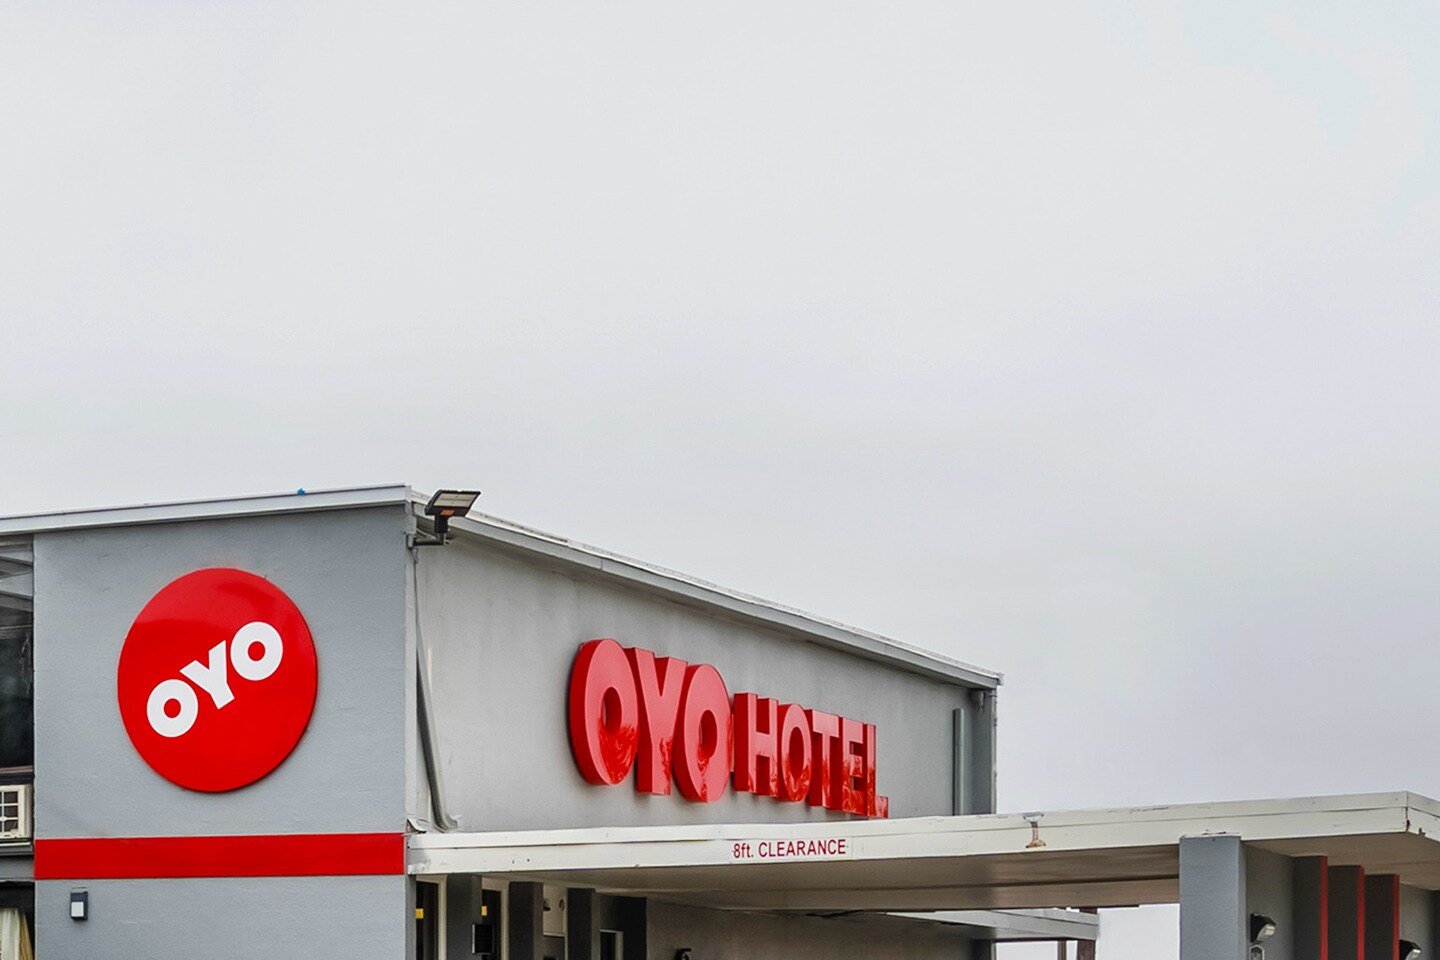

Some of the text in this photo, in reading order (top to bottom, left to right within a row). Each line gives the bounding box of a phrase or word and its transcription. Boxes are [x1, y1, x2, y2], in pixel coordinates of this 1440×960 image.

[146, 621, 284, 738] OYO
[568, 638, 889, 819] OYO HOTEL
[733, 839, 847, 858] 8ft. CLEARANCE
